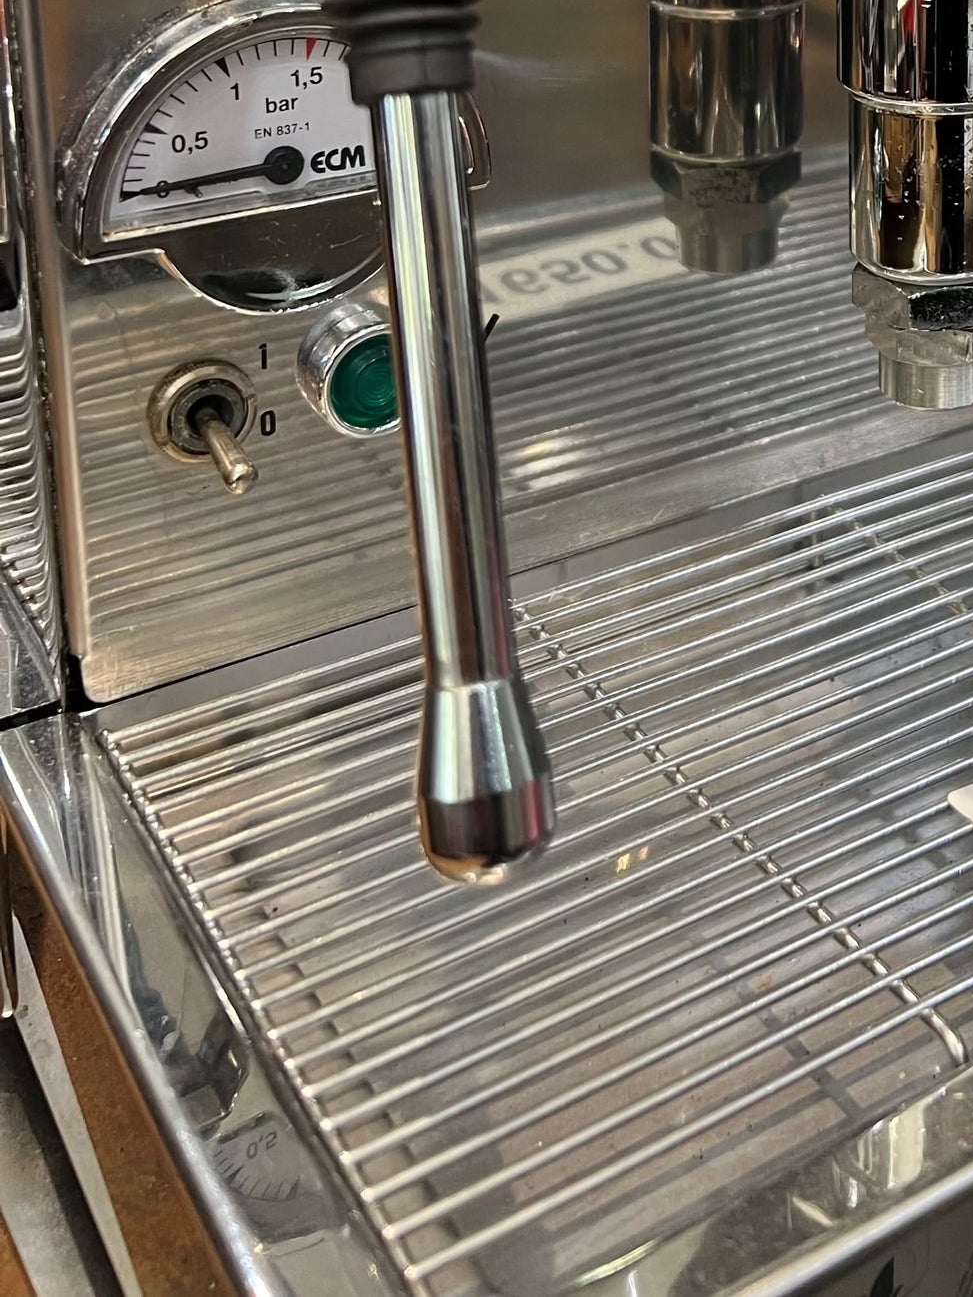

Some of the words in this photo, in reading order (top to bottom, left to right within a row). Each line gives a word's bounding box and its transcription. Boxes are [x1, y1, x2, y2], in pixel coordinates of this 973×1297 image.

[290, 66, 323, 91] 1,5
[230, 82, 240, 101] 1
[265, 96, 299, 114] bar
[171, 130, 209, 155] 0,5
[254, 127, 273, 140] EN
[275, 121, 311, 136] 837-1
[310, 144, 366, 174] ECM
[258, 343, 268, 370] 1
[260, 410, 276, 437] 0
